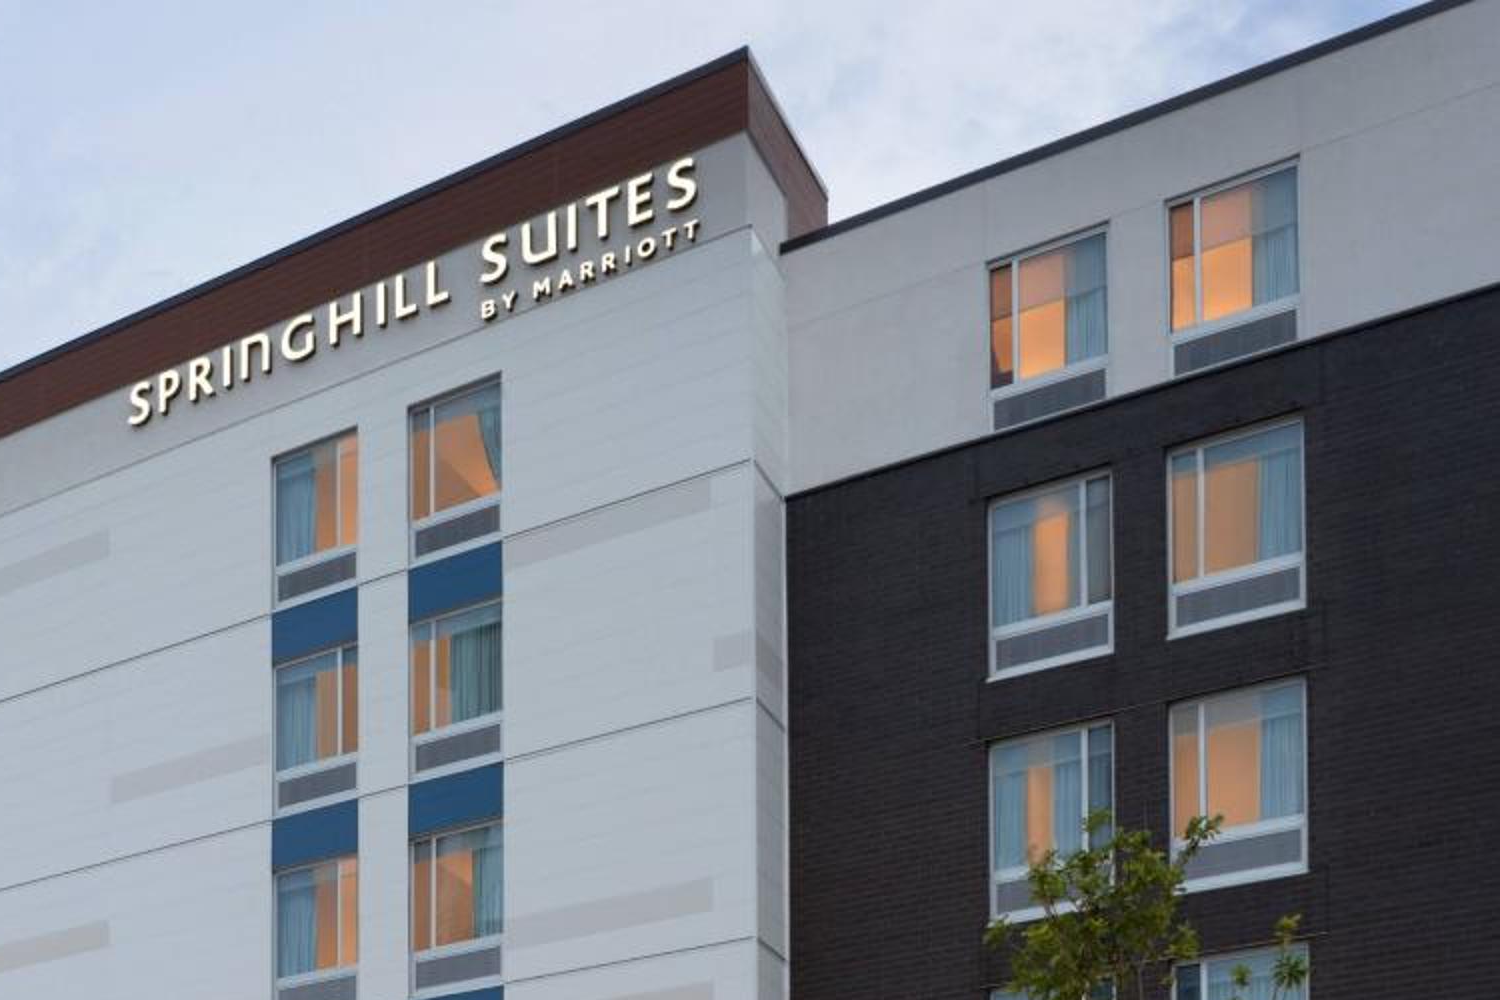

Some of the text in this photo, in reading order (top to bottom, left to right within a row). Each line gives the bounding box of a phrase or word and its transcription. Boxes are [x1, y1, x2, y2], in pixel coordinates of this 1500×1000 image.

[127, 157, 699, 427] SPRINGHILL SUITES
[481, 219, 700, 320] BY MARRIOTT
